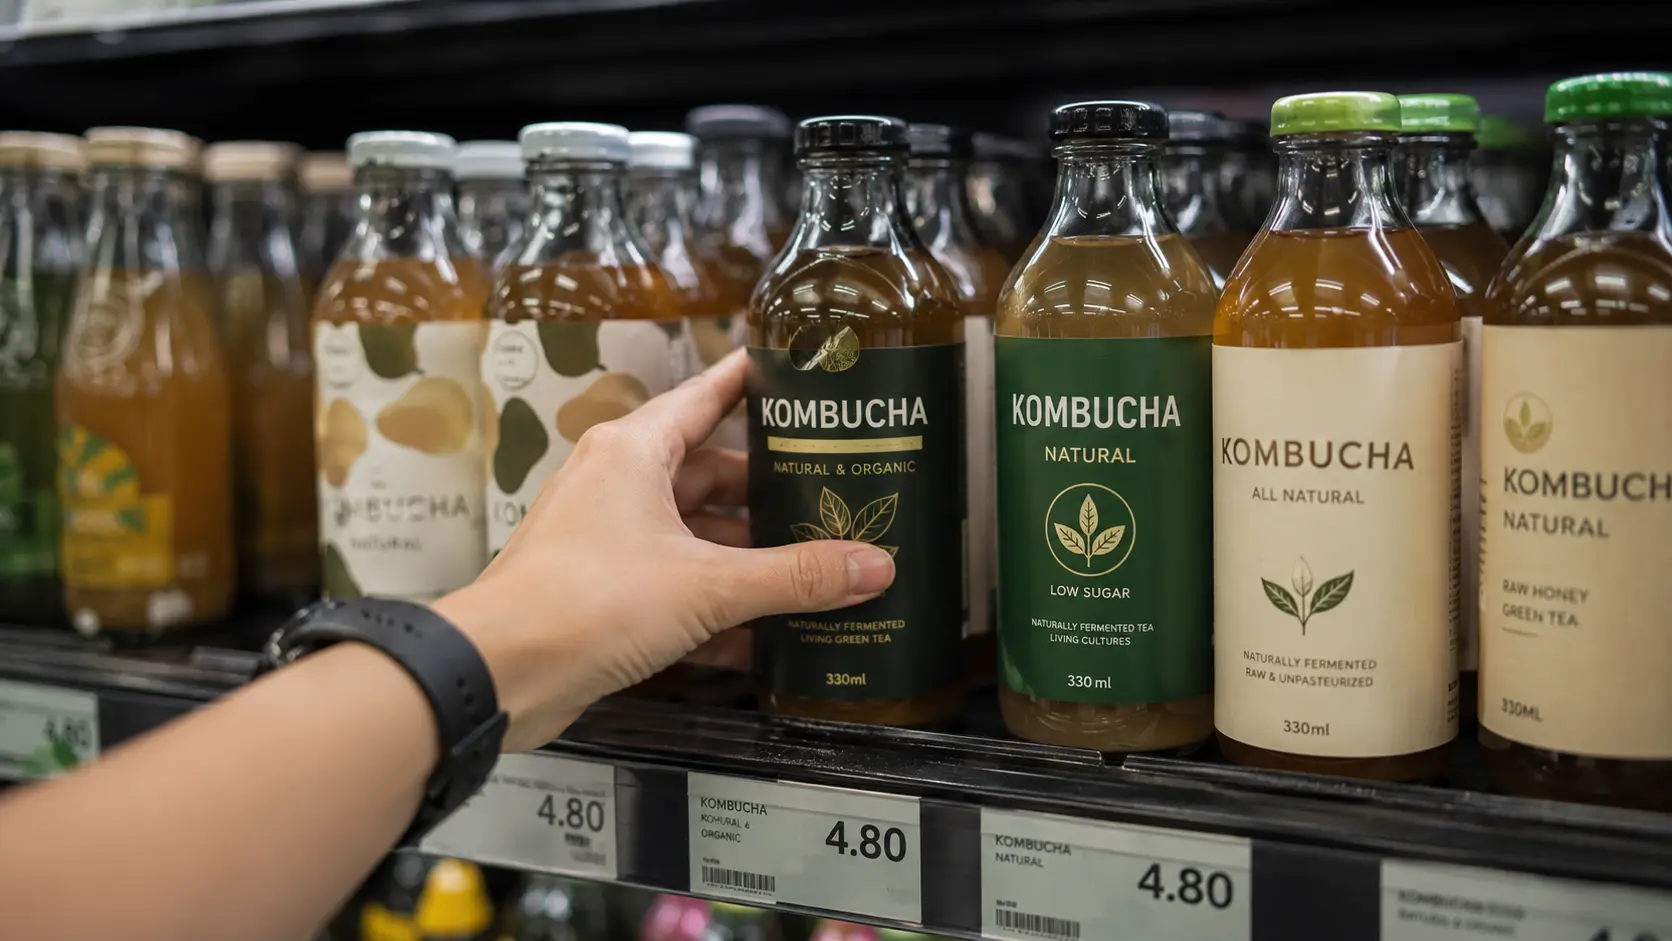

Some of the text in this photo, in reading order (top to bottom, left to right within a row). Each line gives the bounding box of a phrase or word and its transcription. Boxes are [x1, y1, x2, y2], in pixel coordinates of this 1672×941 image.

[761, 396, 929, 429] KOMBUCHA
[1012, 393, 1182, 429] KOMBUCHA
[1044, 445, 1137, 464] NATURAL
[1221, 437, 1415, 471] KOMBUCHA
[773, 460, 916, 476] NATURAL & ORGANIC
[1503, 465, 1672, 502] KOMBUCH
[1251, 486, 1365, 504] ALL NATURAL
[1503, 510, 1611, 539] NATURAL
[1050, 584, 1131, 599] LOW SUGAR
[1502, 579, 1589, 605] RAW HONEY
[787, 619, 906, 631] NATURALLY FERMENTED
[1031, 617, 1155, 633] NATURALLY FERMENTED TEA
[1502, 602, 1580, 628] GREEN TEA
[800, 634, 892, 645] LIVING GREEN TEA
[1049, 634, 1131, 646] LIVING CULTURES
[1243, 650, 1377, 671] NATURALLY FERMENTED
[825, 672, 867, 686] 330ml
[1245, 667, 1374, 688] RAW & UNPASTEURIZED
[1282, 719, 1331, 737] 330ml
[536, 793, 606, 833] 4.80
[700, 796, 768, 816] KOMBUCHA
[700, 828, 742, 843] ORGANIC
[825, 820, 907, 863] 4.80
[994, 833, 1072, 856] KOMBUCHA
[994, 852, 1045, 869] NATURAL
[1136, 863, 1234, 910] 4.80
